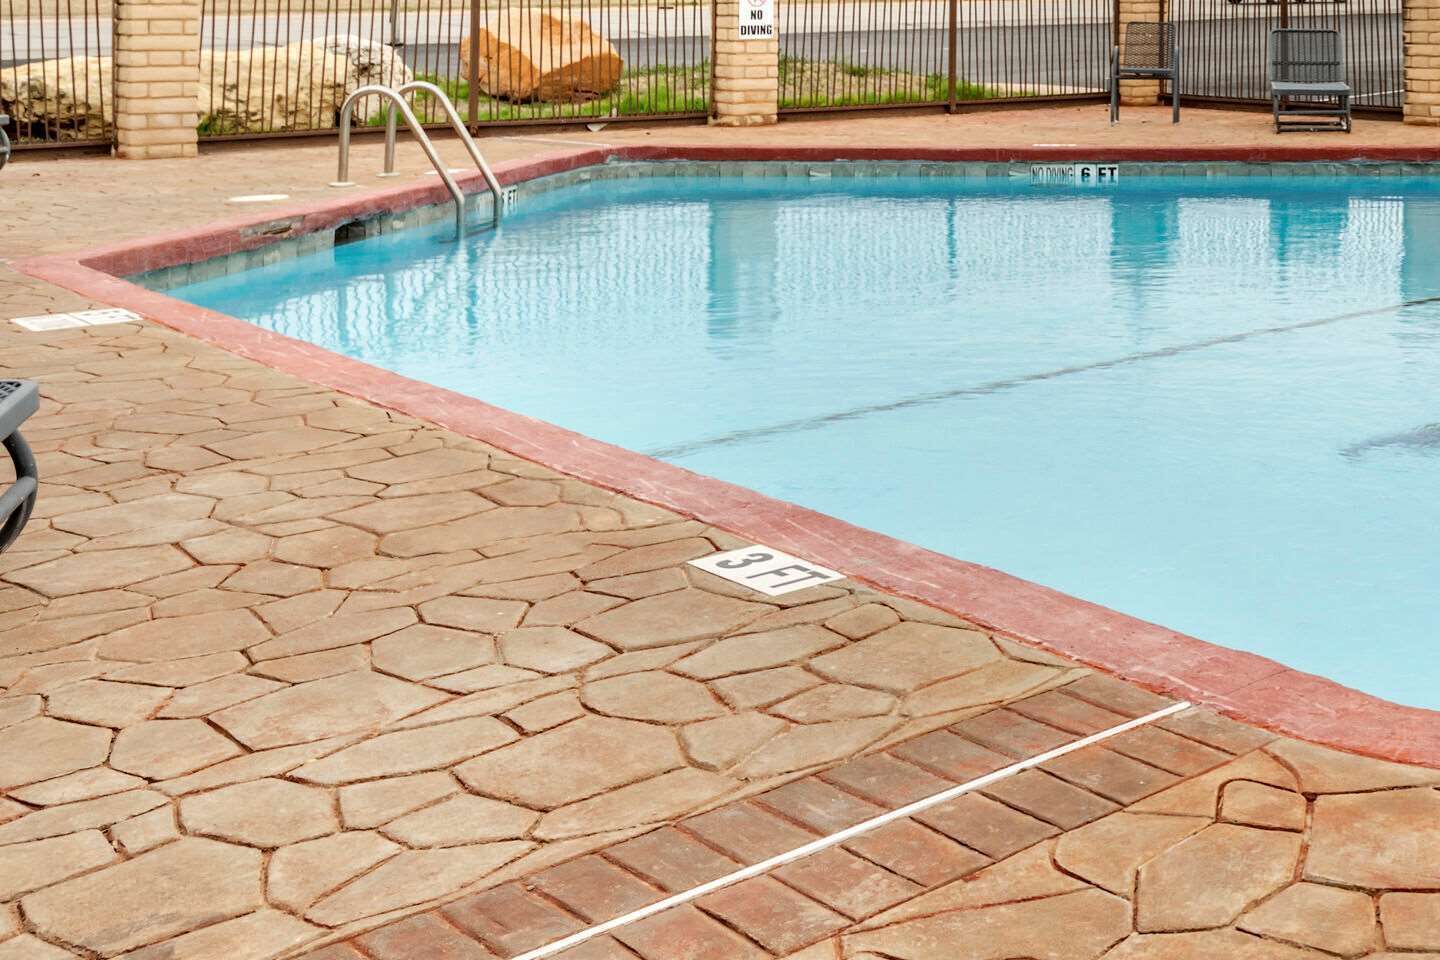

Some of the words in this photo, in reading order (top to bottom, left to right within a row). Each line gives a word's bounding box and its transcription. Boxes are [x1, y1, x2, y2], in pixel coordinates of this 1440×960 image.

[750, 9, 763, 20] NO
[740, 24, 772, 35] DIVING
[1032, 167, 1044, 177] NO
[1046, 167, 1074, 177] DIVING
[1081, 167, 1091, 177] 6
[1098, 167, 1117, 177] FT
[715, 552, 774, 569] 3
[745, 564, 831, 589] FT
